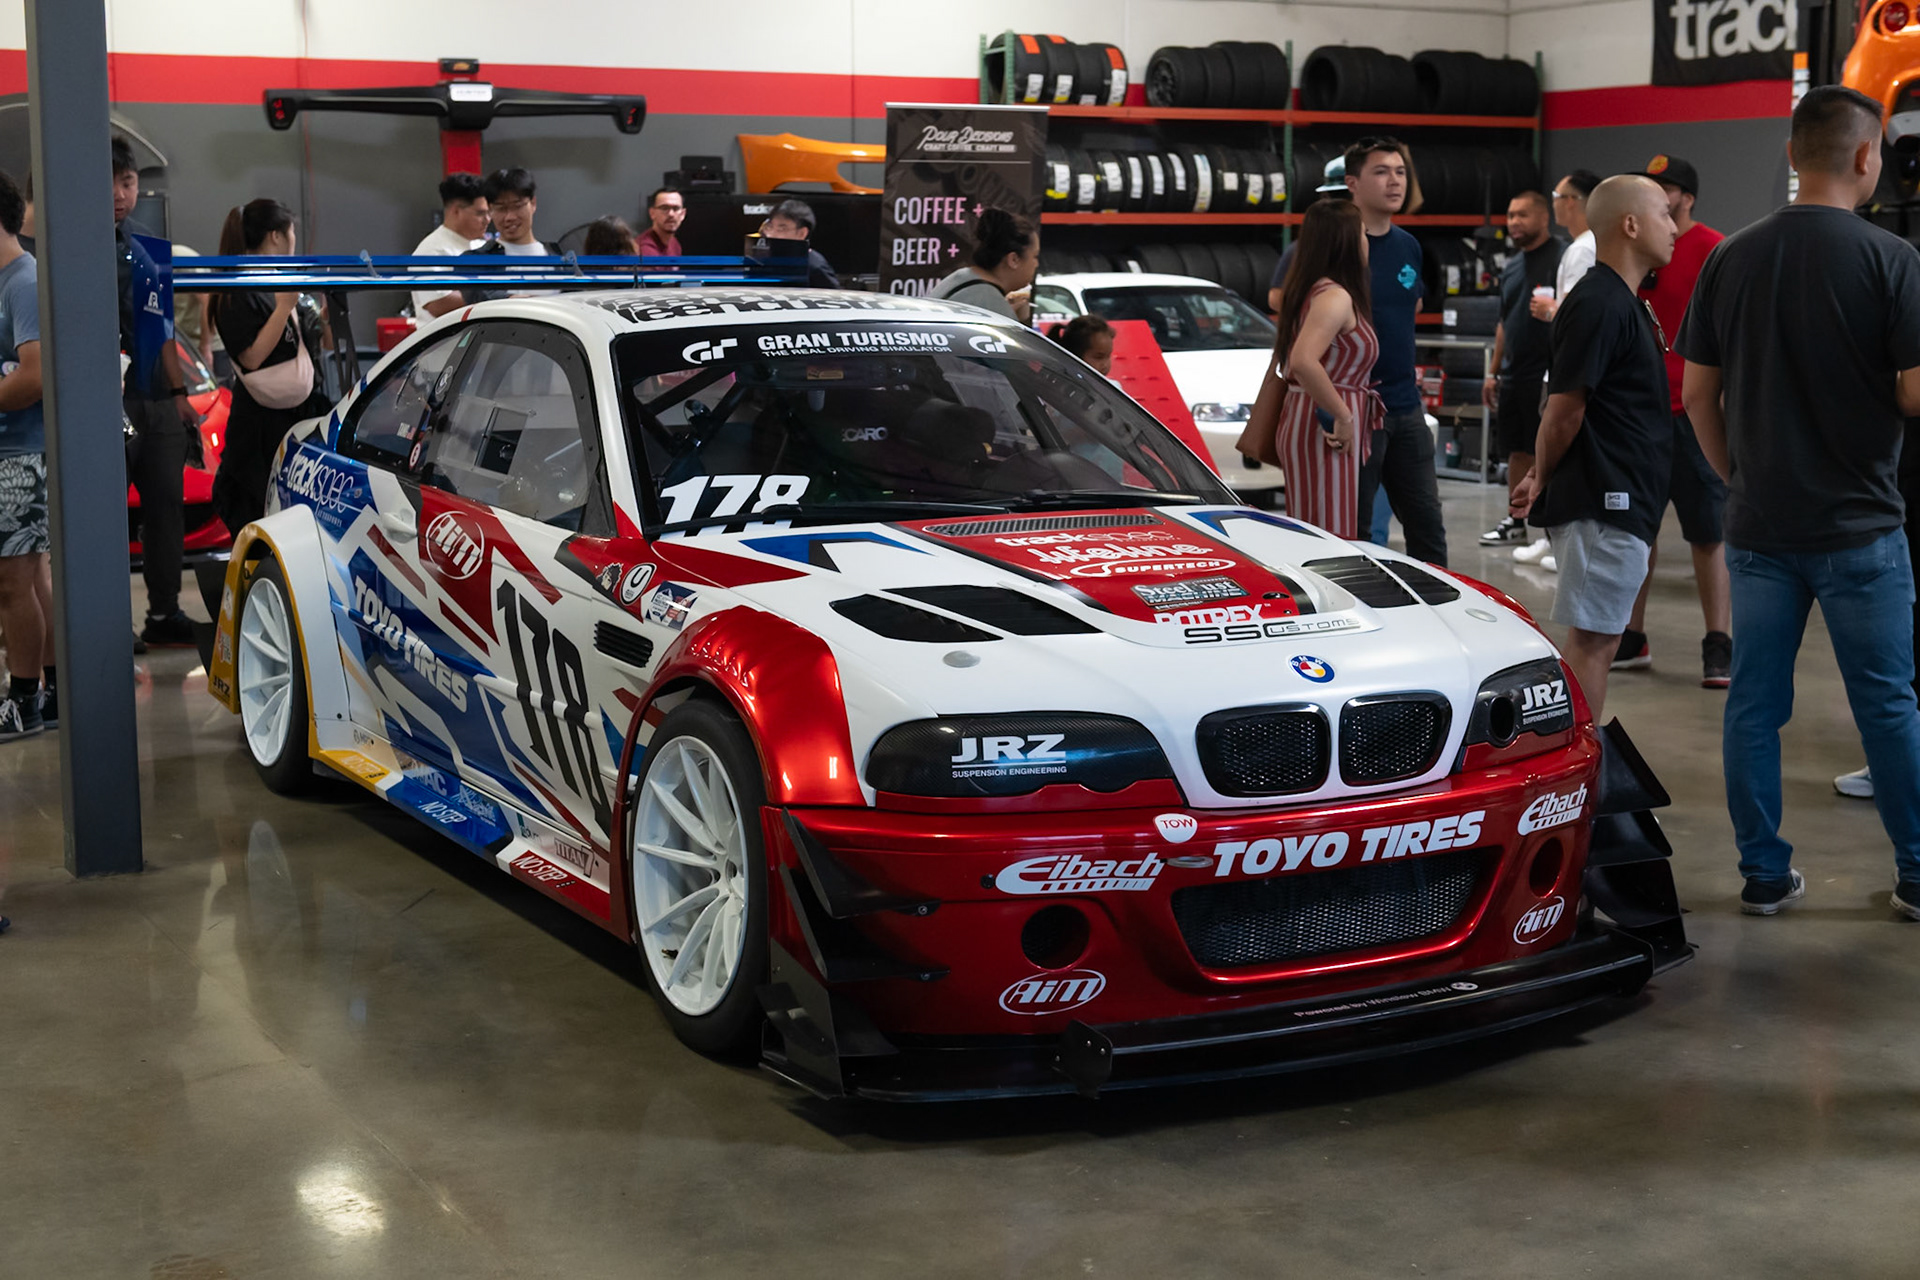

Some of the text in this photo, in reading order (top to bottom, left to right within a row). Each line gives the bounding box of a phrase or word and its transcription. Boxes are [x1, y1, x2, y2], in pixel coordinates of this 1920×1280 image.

[894, 197, 967, 225] COFFEE
[892, 237, 941, 266] BEER
[757, 332, 831, 351] GRAN
[761, 349, 790, 357] THE
[790, 347, 826, 355] REAL
[880, 345, 953, 353] SIMULATOR
[658, 474, 811, 539] 178
[1113, 559, 1222, 575] SUPERTECH
[353, 574, 470, 714] TOYO TIRES
[212, 674, 231, 699] JRZ
[1521, 679, 1568, 712] JRZ
[496, 577, 613, 841] 178
[951, 733, 1067, 764] JRZ
[951, 765, 1068, 779] SUSPENSION ENGINEERING
[418, 801, 468, 825] NO STEP
[1159, 817, 1194, 829] TOW
[1516, 783, 1588, 836] Eibach
[1212, 810, 1486, 877] TOYO TIRES
[510, 855, 569, 882] NO STEP
[994, 852, 1167, 895] Eibach
[1293, 1003, 1351, 1018] Powered
[1350, 1000, 1368, 1010] by
